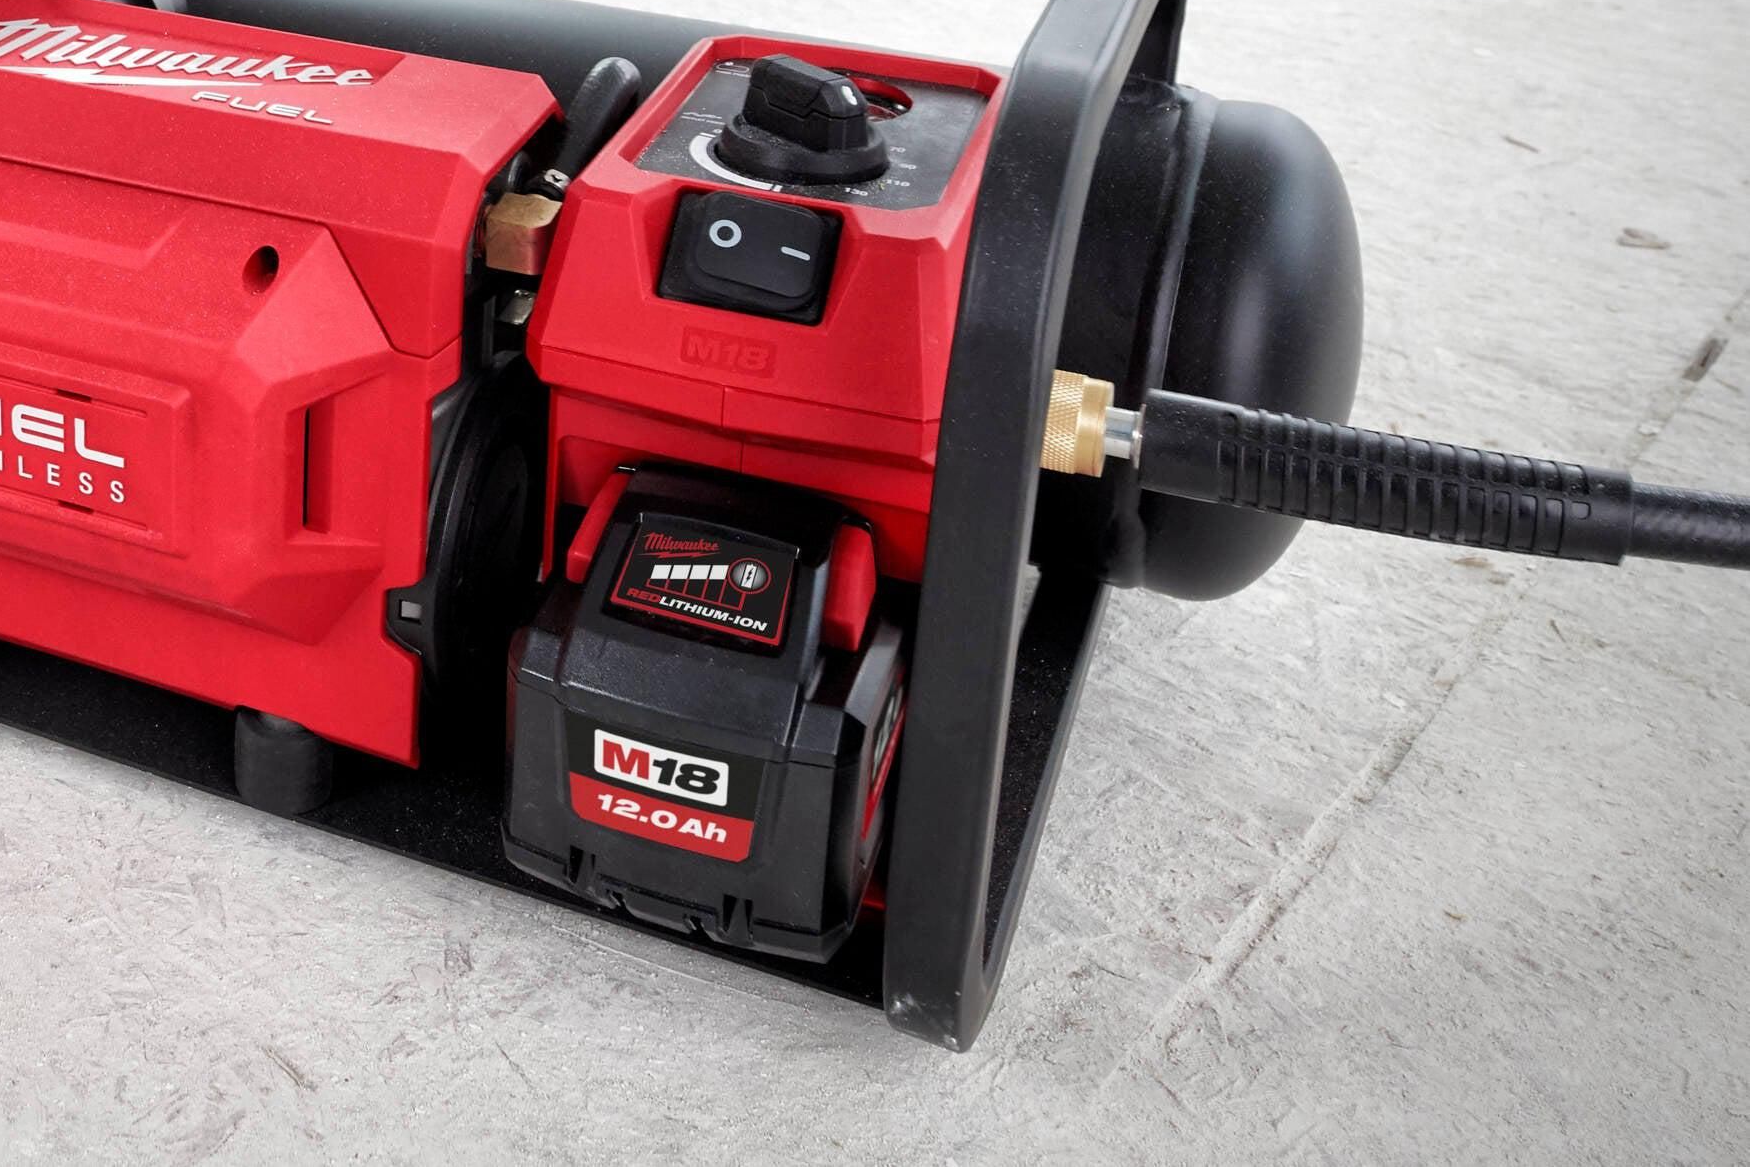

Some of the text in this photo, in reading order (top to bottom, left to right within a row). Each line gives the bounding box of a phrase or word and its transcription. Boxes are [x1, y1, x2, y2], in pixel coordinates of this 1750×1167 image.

[191, 91, 333, 125] FUEL
[685, 333, 770, 371] M18
[642, 532, 720, 552] Milwaukee
[602, 739, 720, 795] M18
